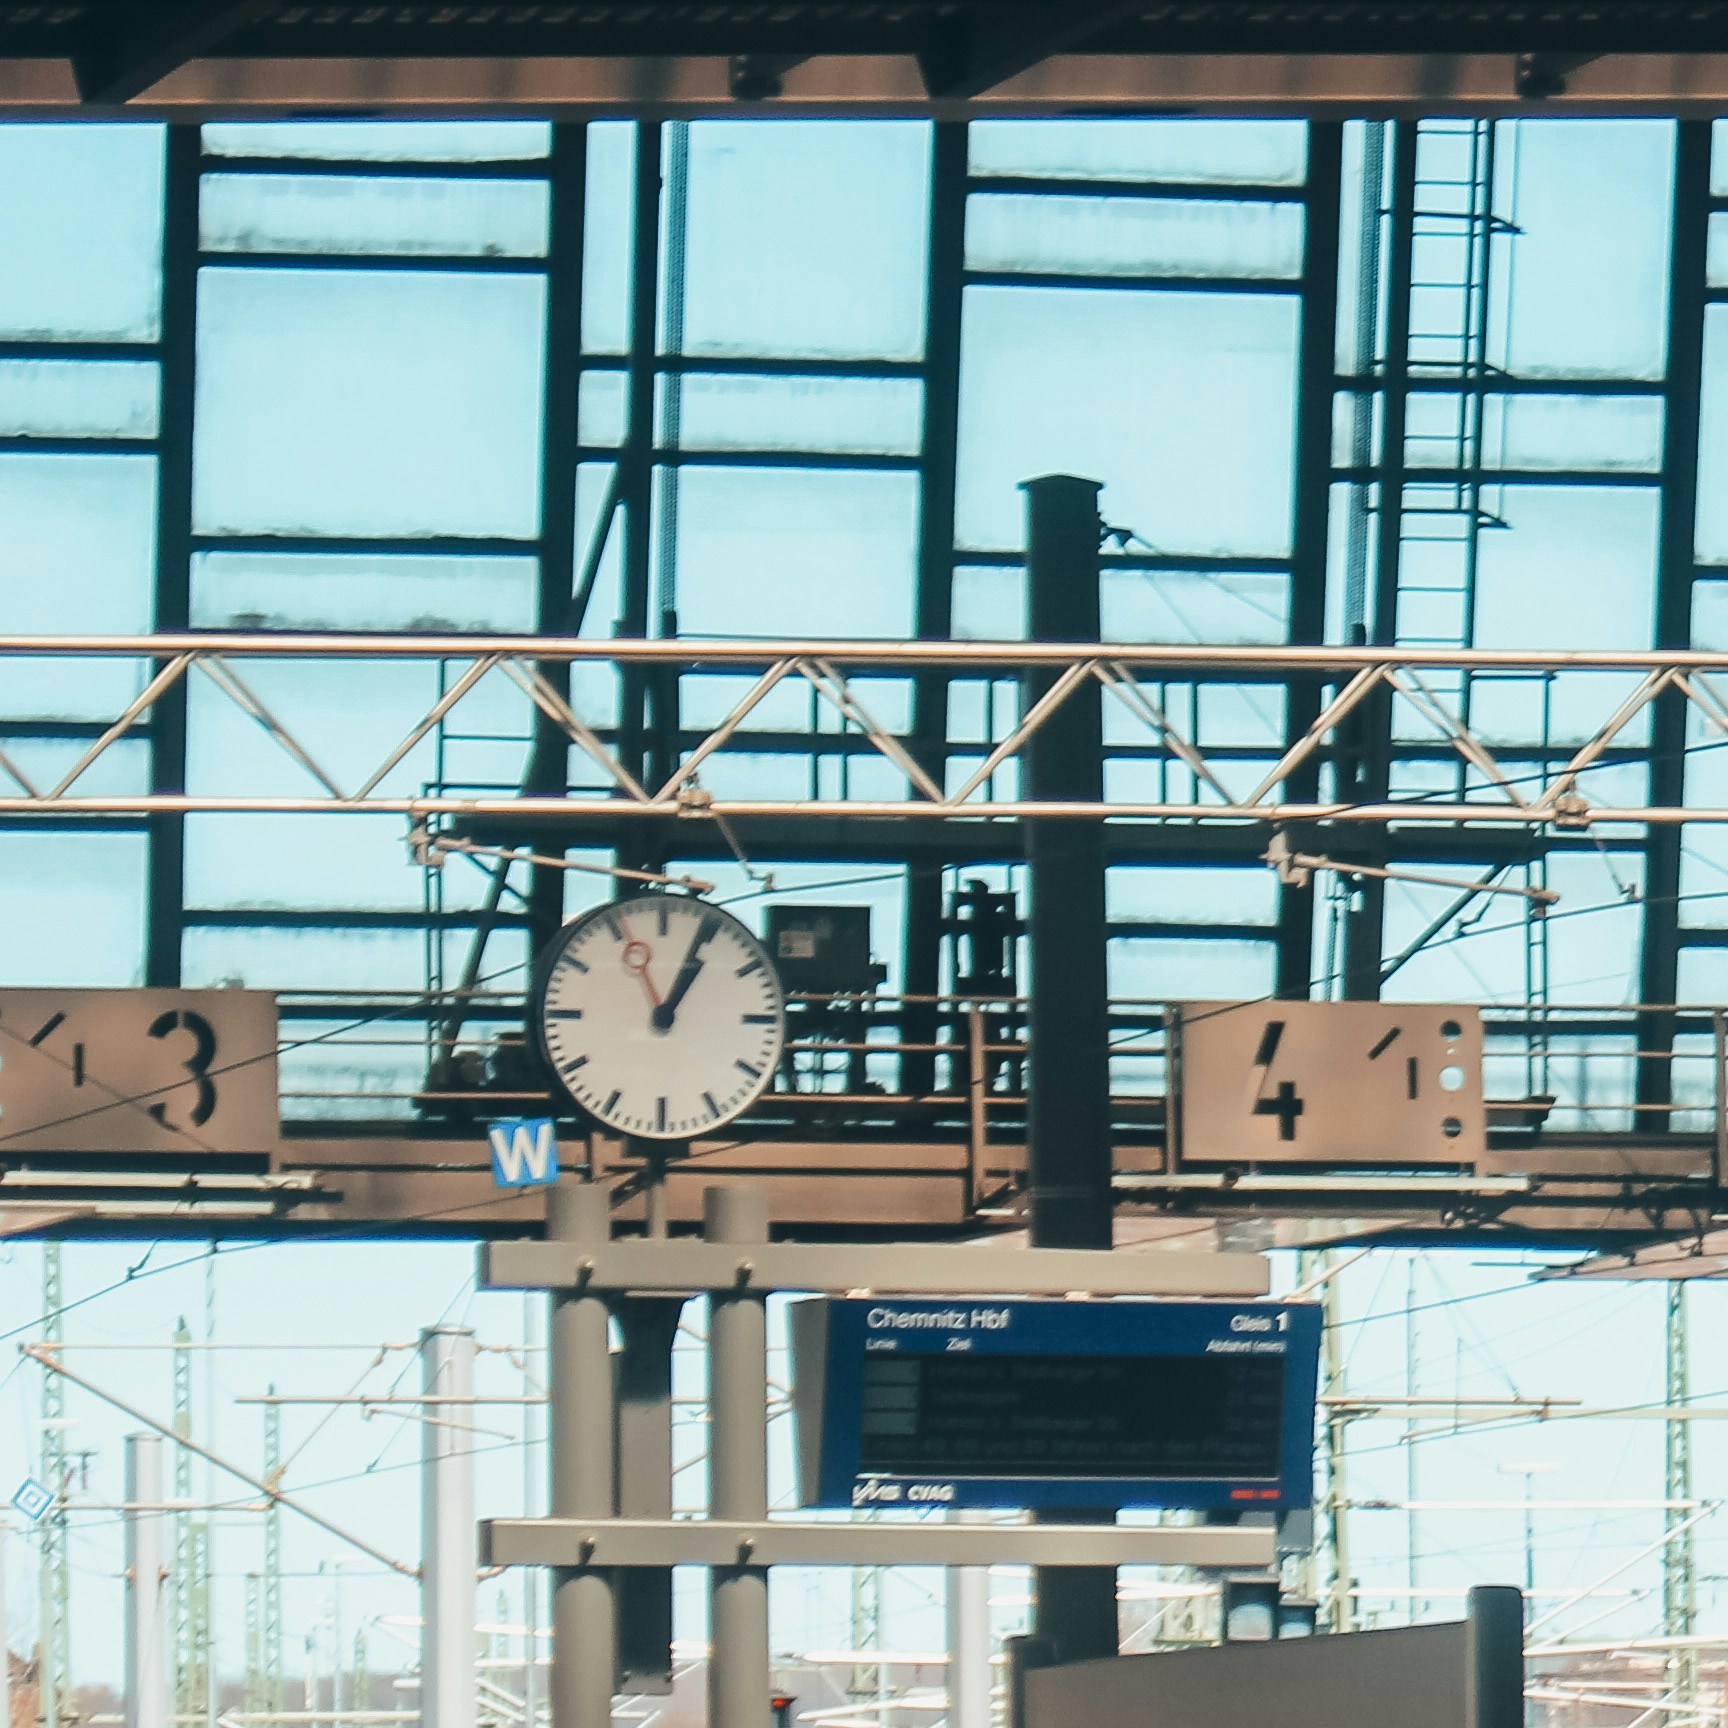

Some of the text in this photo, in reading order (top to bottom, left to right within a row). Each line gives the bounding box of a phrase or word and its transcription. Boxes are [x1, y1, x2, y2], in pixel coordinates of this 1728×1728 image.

[147, 1010, 217, 1132] 3
[1251, 1020, 1305, 1141] 4
[489, 1122, 555, 1183] W
[866, 1307, 1010, 1329] Chemnitz Hbf
[1275, 1311, 1289, 1332] 1
